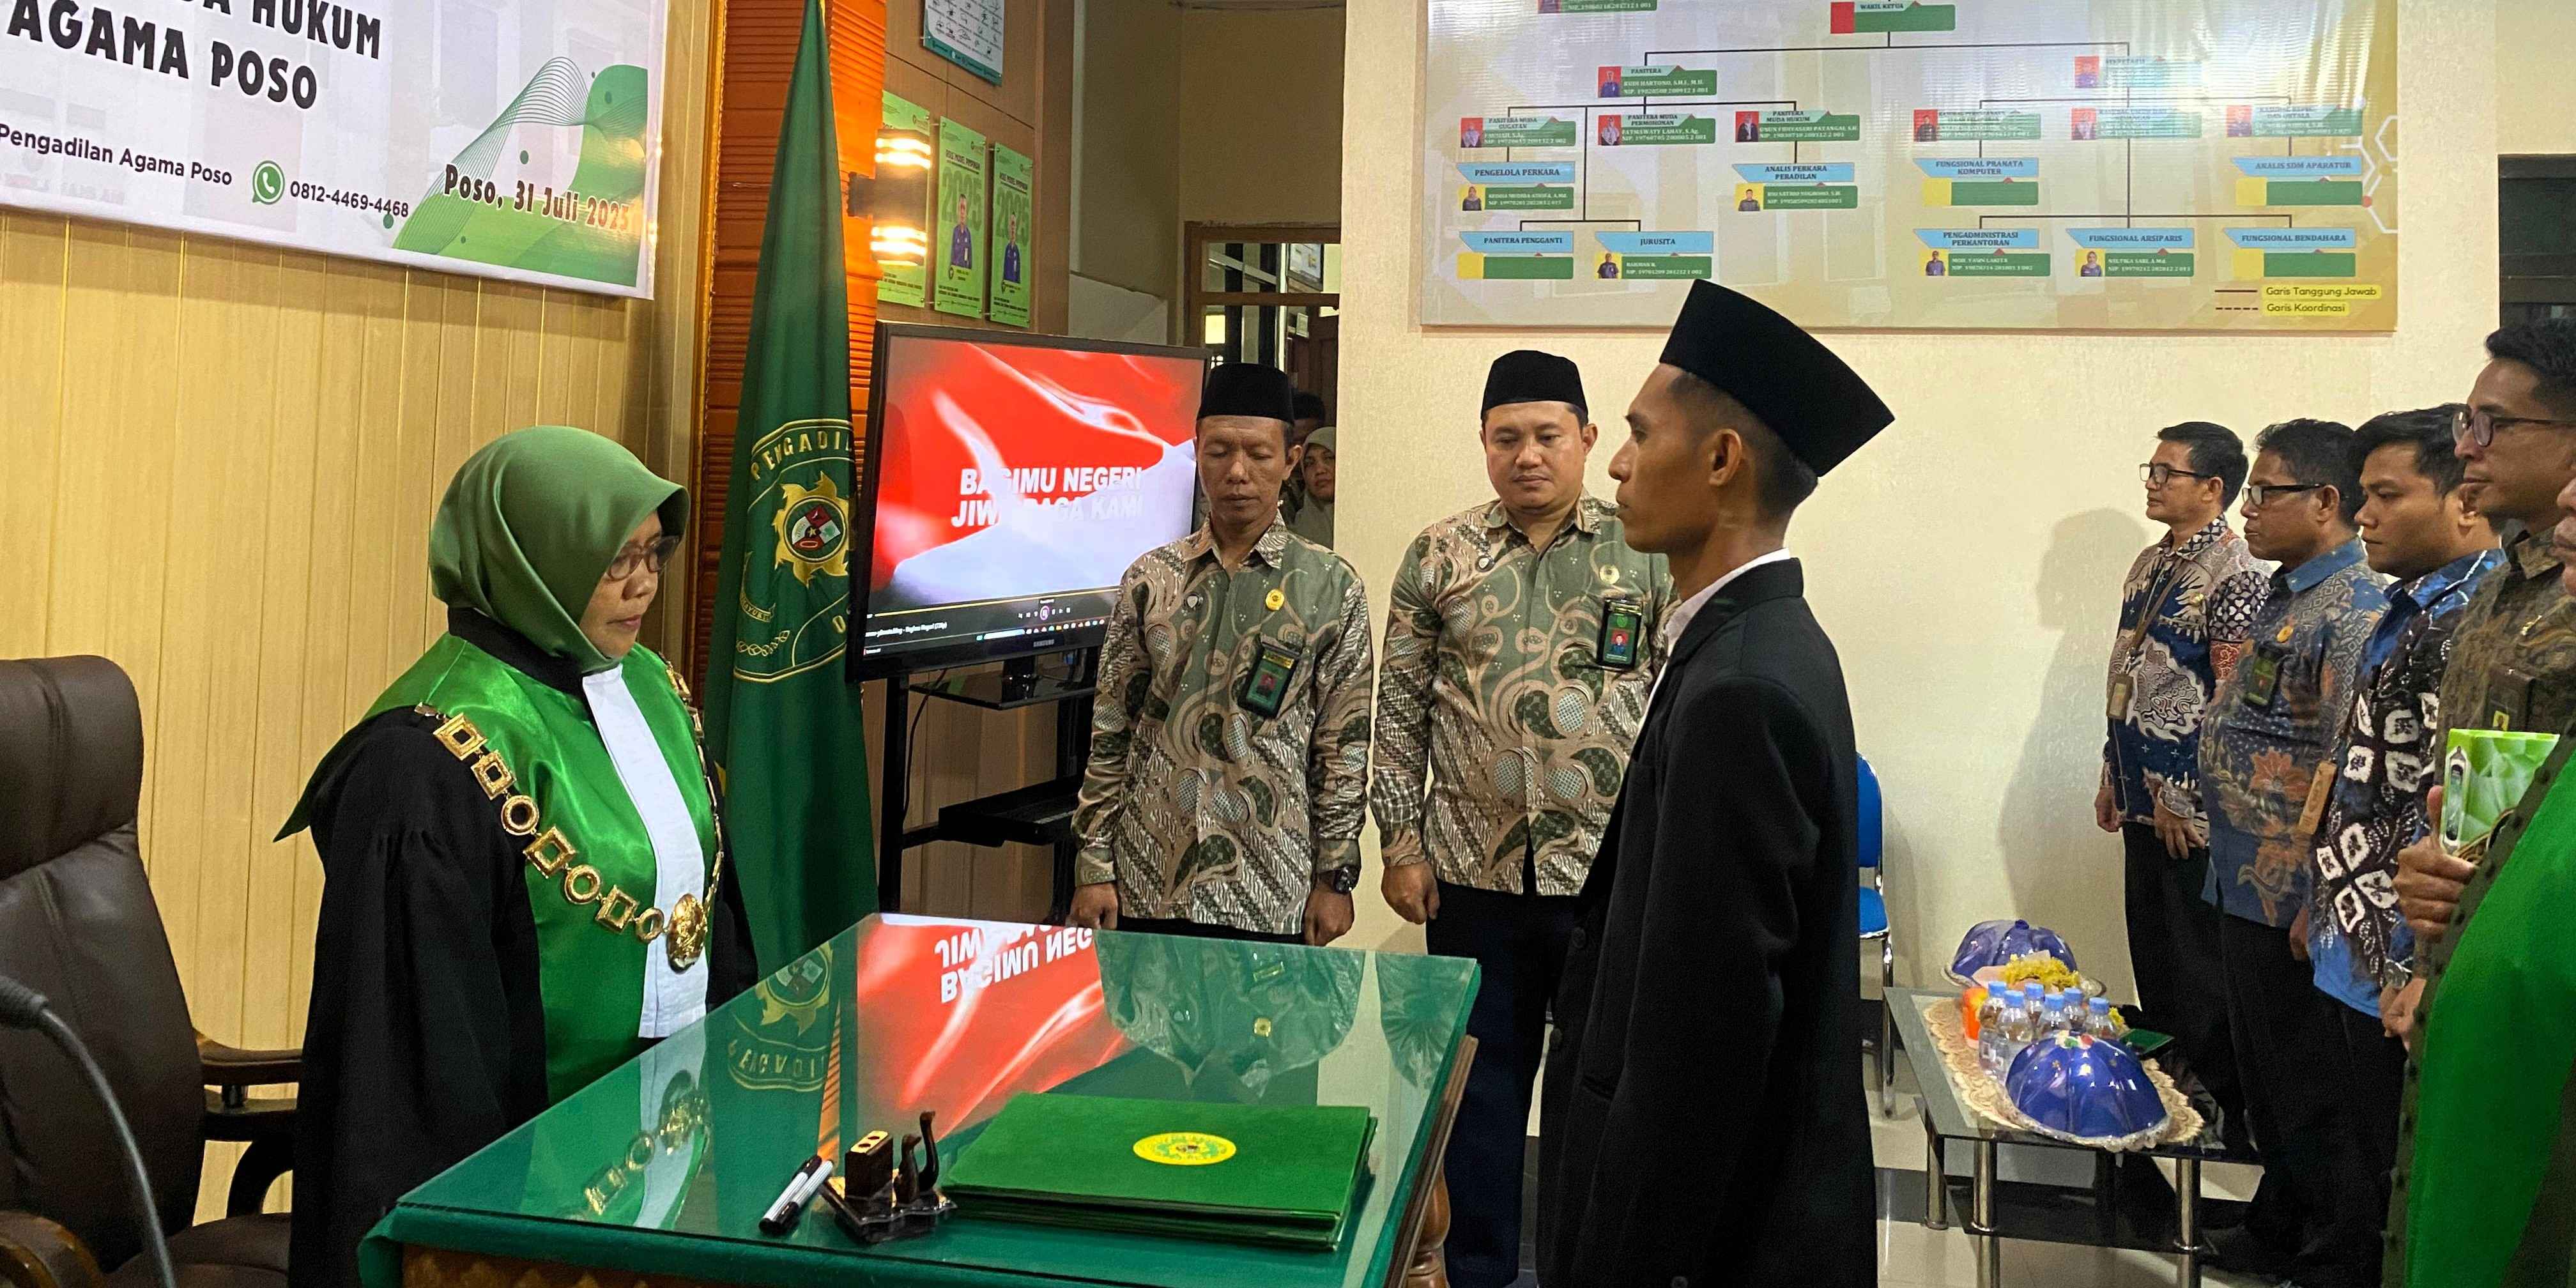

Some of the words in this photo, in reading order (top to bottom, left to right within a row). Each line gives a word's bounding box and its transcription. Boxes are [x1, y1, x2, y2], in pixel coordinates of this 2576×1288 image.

[252, 0, 380, 59] HUKUM
[7, 0, 188, 79] AGAMA
[211, 41, 317, 109] POSO
[119, 148, 185, 177] Agama
[190, 162, 233, 185] Poso
[290, 181, 408, 218] 0812-4469-4468
[444, 164, 503, 209] Poso,
[514, 180, 534, 211] 31
[542, 187, 579, 222] Juli
[586, 200, 629, 229] 2025
[2294, 287, 2342, 296] Tanggung
[2343, 287, 2377, 295] Jawab
[2294, 303, 2345, 311] Koordinasi
